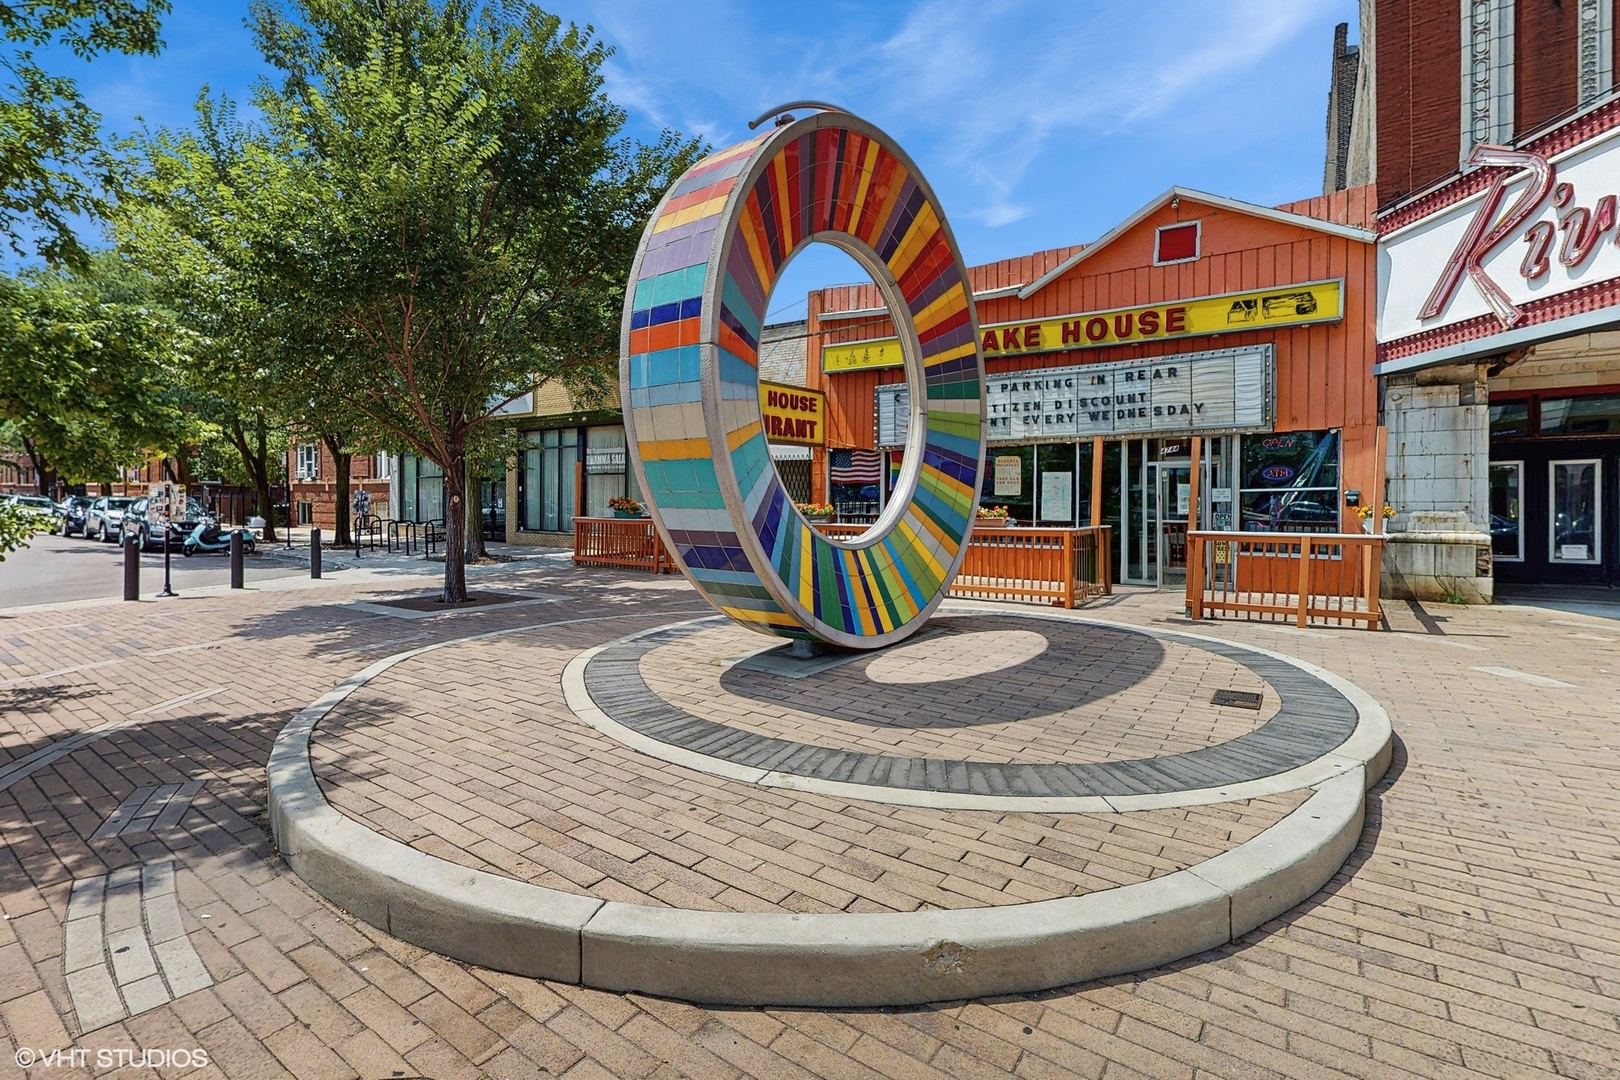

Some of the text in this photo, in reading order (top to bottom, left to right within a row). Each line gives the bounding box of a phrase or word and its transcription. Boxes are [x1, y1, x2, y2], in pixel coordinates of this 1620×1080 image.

[1416, 144, 1620, 330] Riv
[982, 306, 1186, 351] AKE HOUSE
[1001, 378, 1073, 392] PARKING
[1090, 375, 1105, 385] IN
[1125, 367, 1178, 382] REAR
[768, 390, 817, 413] HOUSE
[992, 392, 1146, 413] TIZEN DISCOUNT
[1023, 412, 1075, 425] EVERY
[1088, 403, 1205, 422] WEDNESDAY
[1262, 437, 1293, 448] OPEN
[1267, 469, 1288, 477] ATM
[1215, 513, 1232, 521] OPEN
